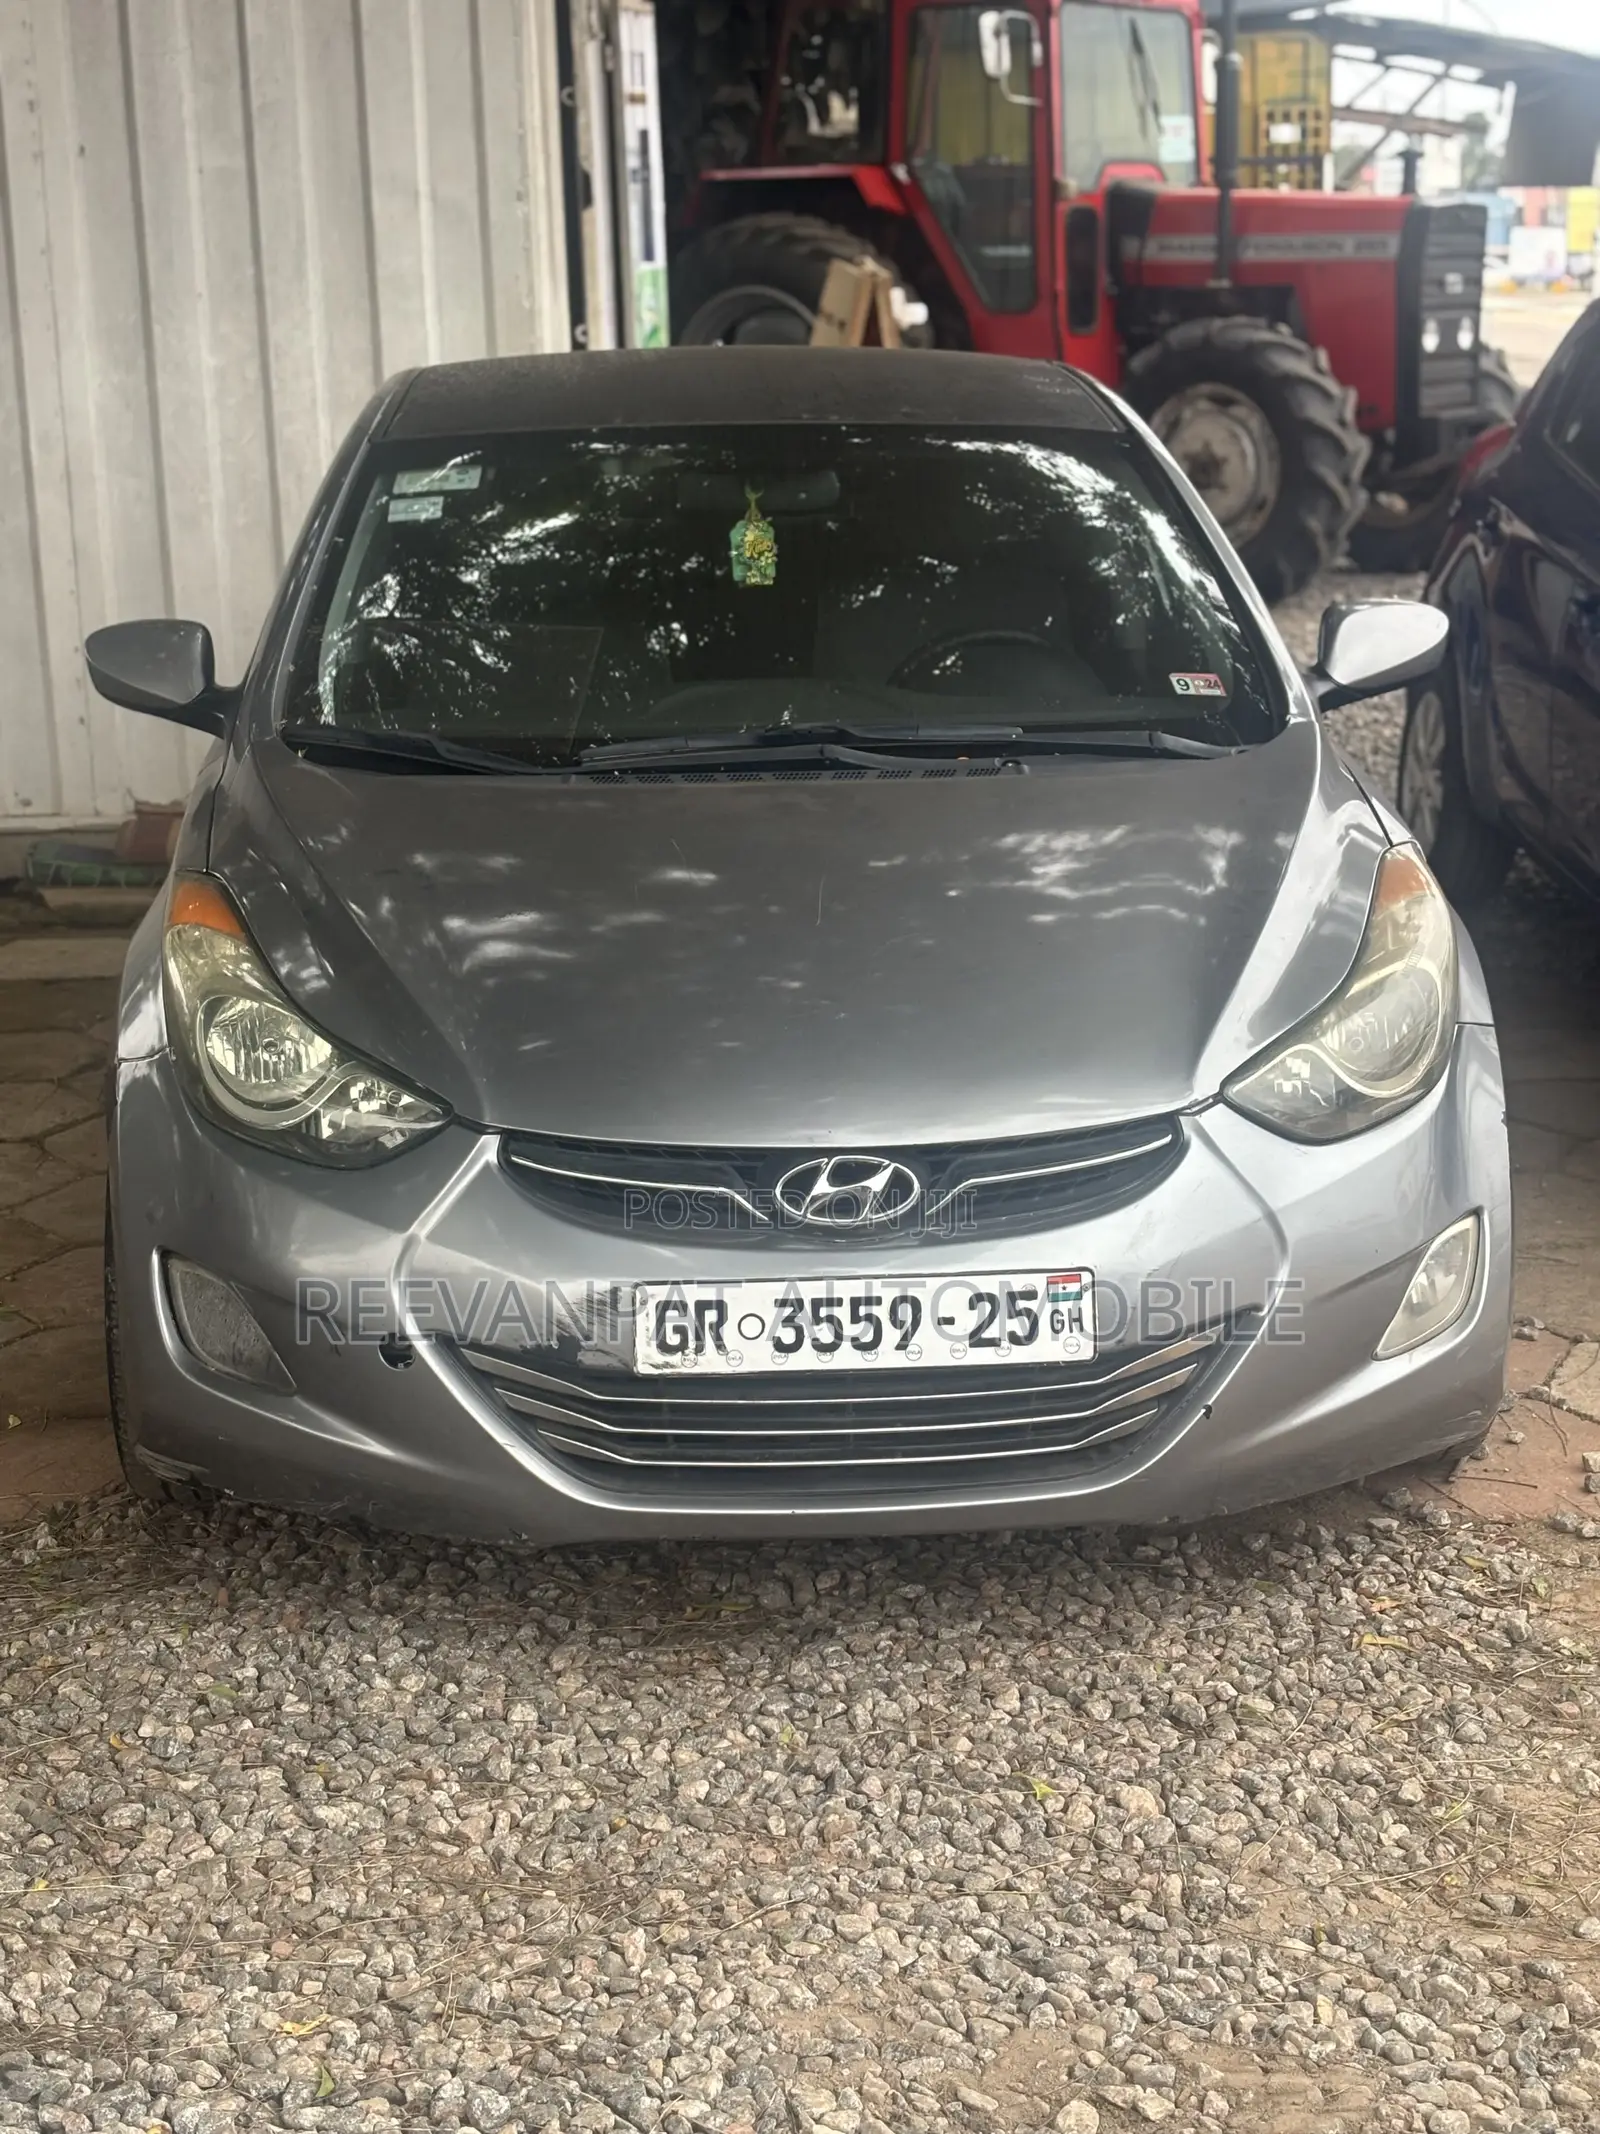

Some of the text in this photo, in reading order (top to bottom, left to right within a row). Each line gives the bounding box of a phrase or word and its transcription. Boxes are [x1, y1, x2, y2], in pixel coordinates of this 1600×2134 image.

[1175, 678, 1190, 691] 9
[656, 1299, 729, 1355] GR
[1050, 1307, 1084, 1335] GH
